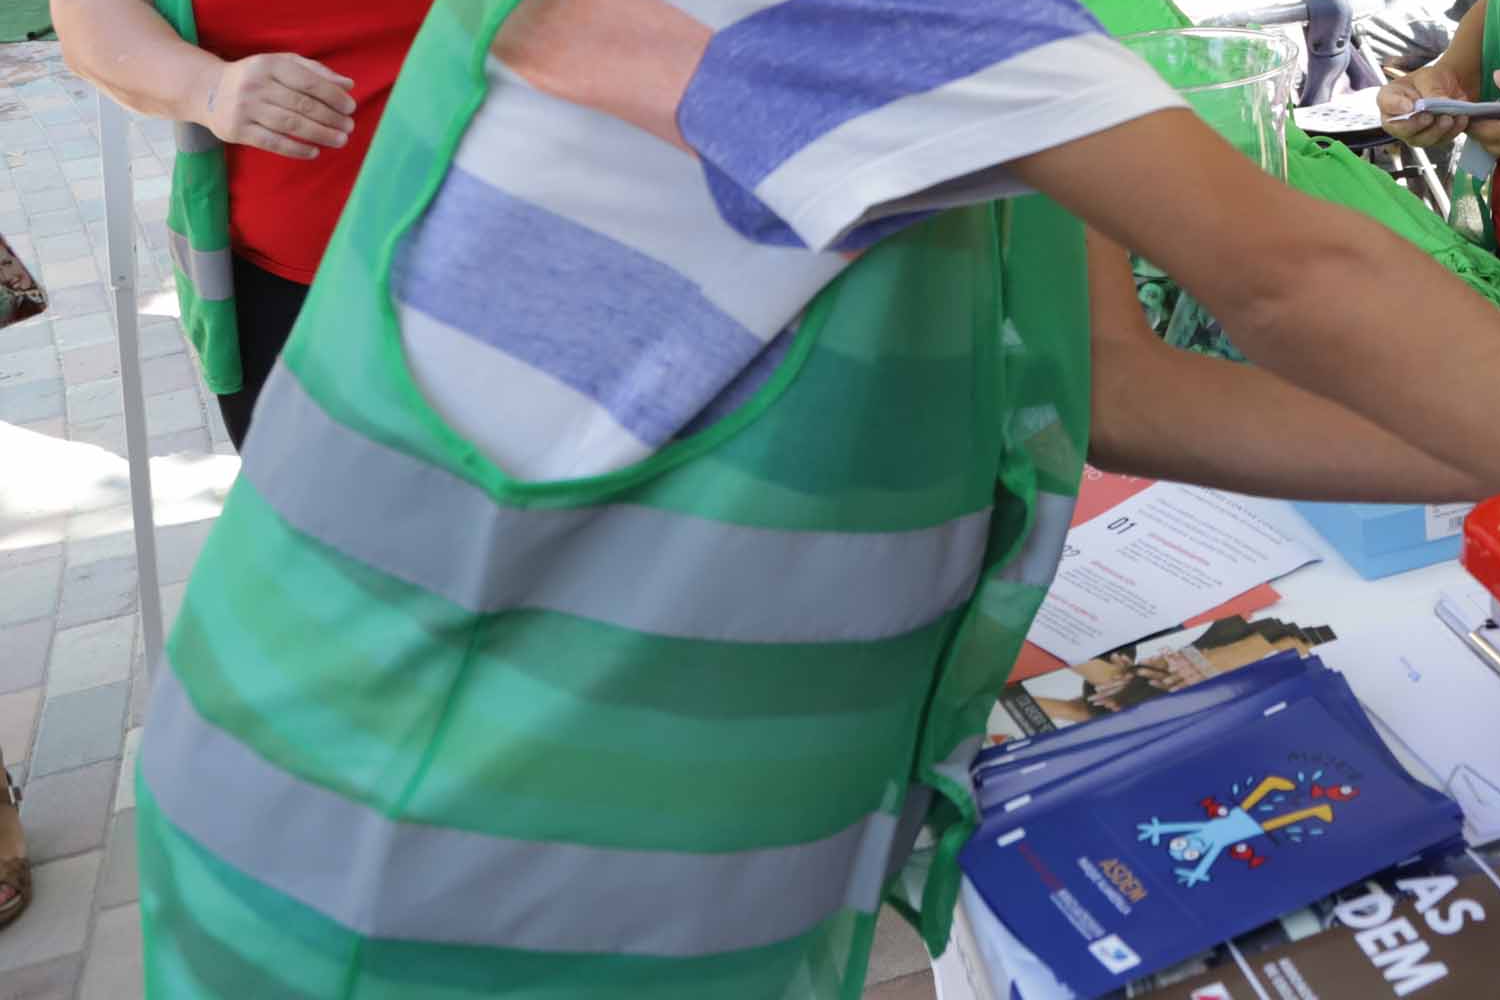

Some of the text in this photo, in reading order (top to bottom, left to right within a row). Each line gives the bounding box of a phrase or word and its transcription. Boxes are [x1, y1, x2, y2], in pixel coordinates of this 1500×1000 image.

[1107, 516, 1136, 535] 01
[1396, 873, 1487, 936] AS
[1333, 880, 1450, 998] DEM
